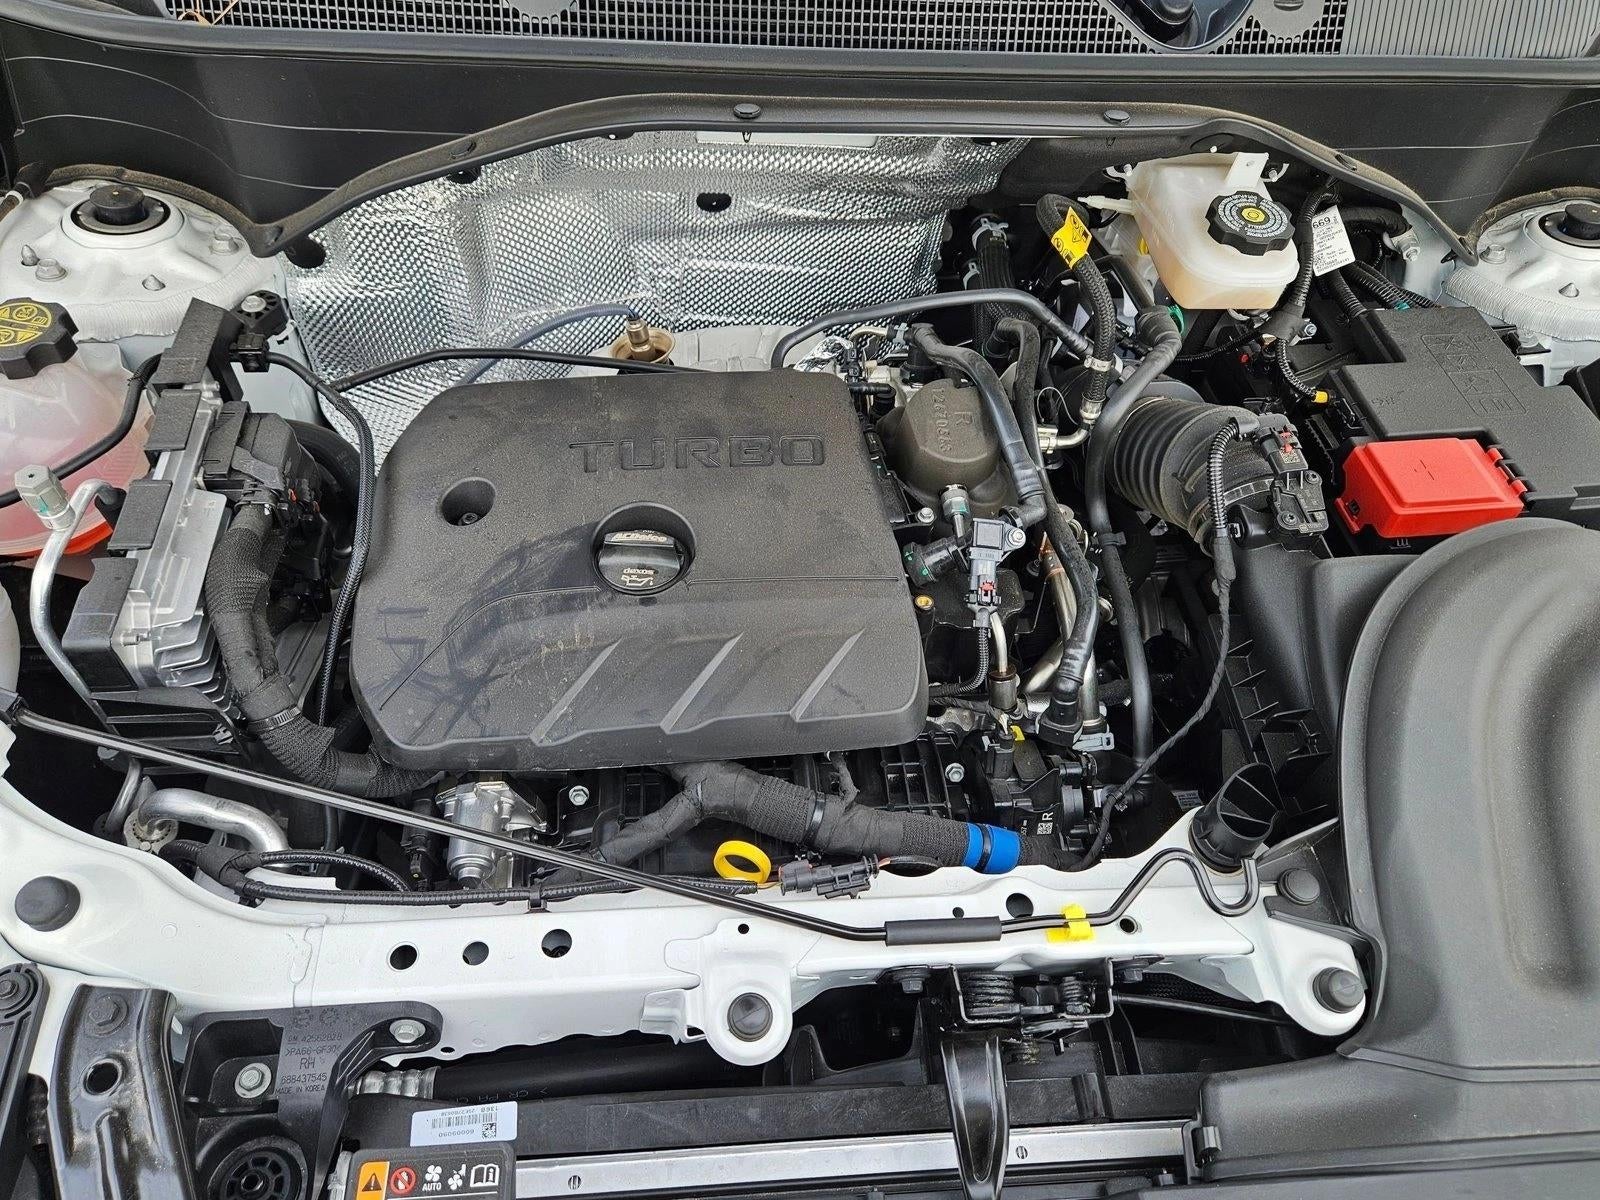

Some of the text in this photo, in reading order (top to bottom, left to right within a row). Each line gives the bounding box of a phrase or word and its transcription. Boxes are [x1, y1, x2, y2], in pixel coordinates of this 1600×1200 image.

[568, 434, 826, 474] TURBO
[1042, 811, 1054, 821] R
[299, 1056, 316, 1070] RH
[304, 1084, 326, 1092] KOREA
[422, 1182, 442, 1192] AUTO
